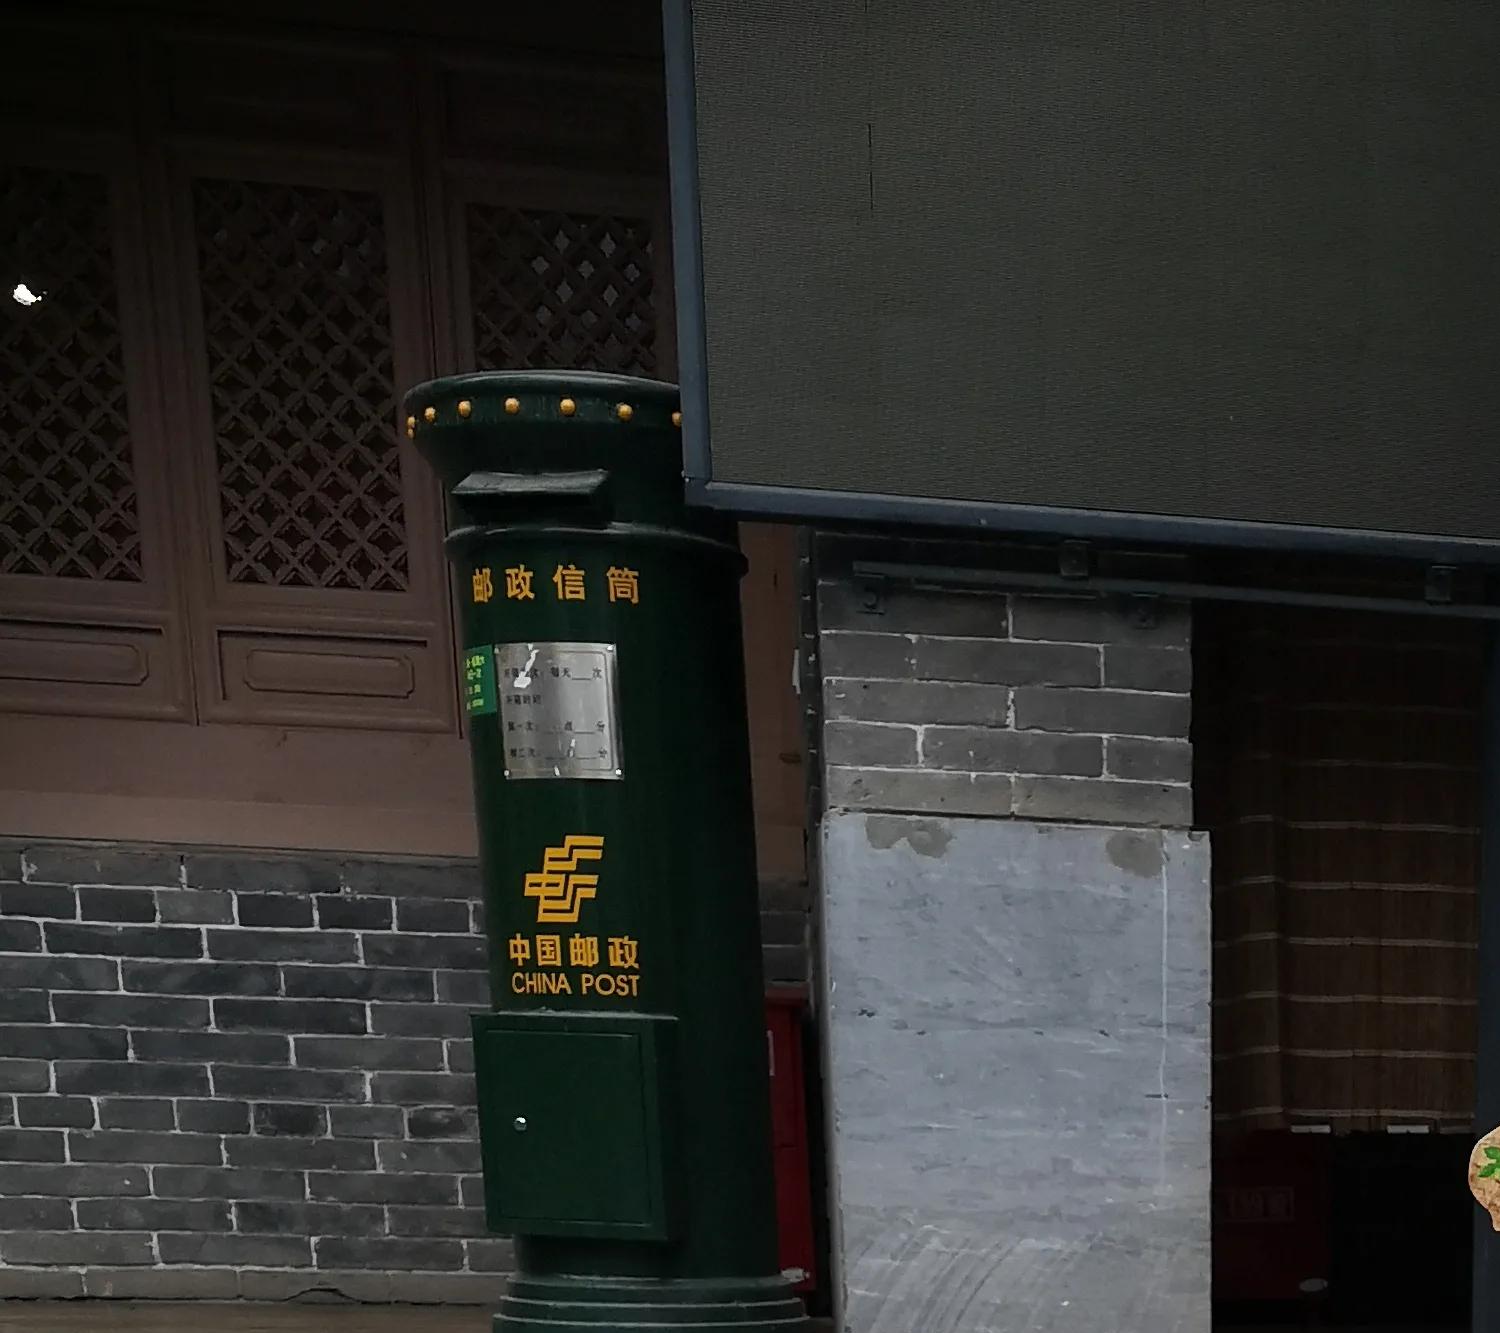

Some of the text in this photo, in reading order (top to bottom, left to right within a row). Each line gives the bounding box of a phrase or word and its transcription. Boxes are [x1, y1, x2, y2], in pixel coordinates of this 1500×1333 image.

[472, 564, 639, 604] 邮政信筒
[509, 933, 640, 969] 中国邮政
[511, 972, 640, 997] CHINA POST
